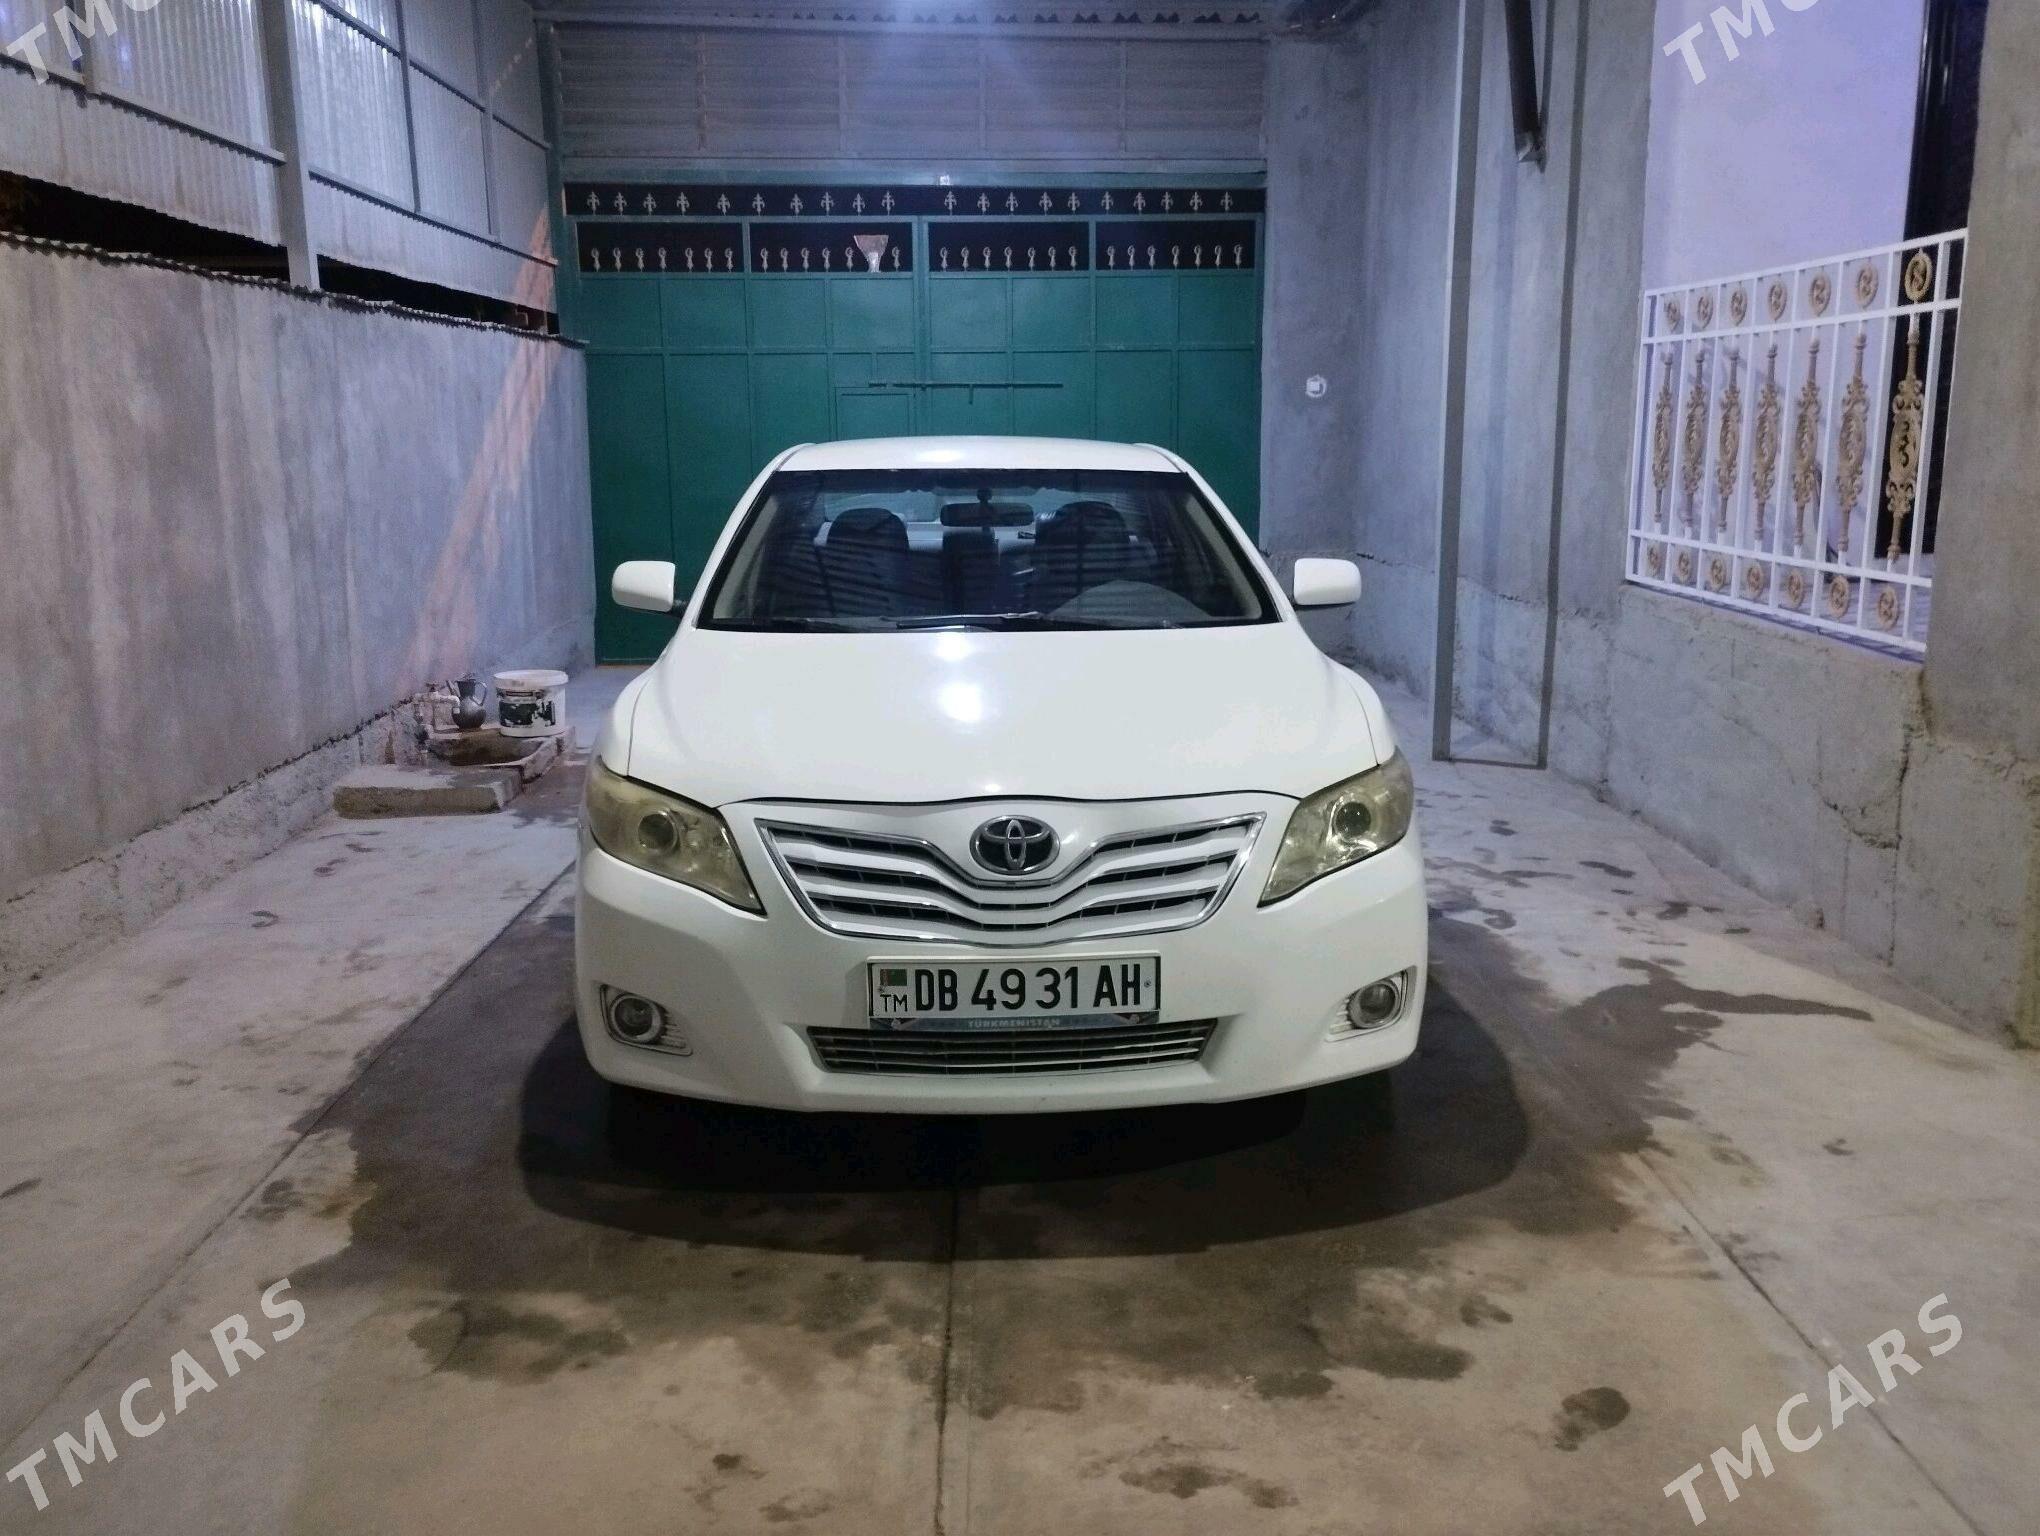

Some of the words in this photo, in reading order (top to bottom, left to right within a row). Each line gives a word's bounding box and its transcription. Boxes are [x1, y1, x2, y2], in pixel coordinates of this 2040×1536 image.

[879, 994, 908, 1012] TM
[914, 969, 958, 1012] DB
[1093, 963, 1142, 1008] AH
